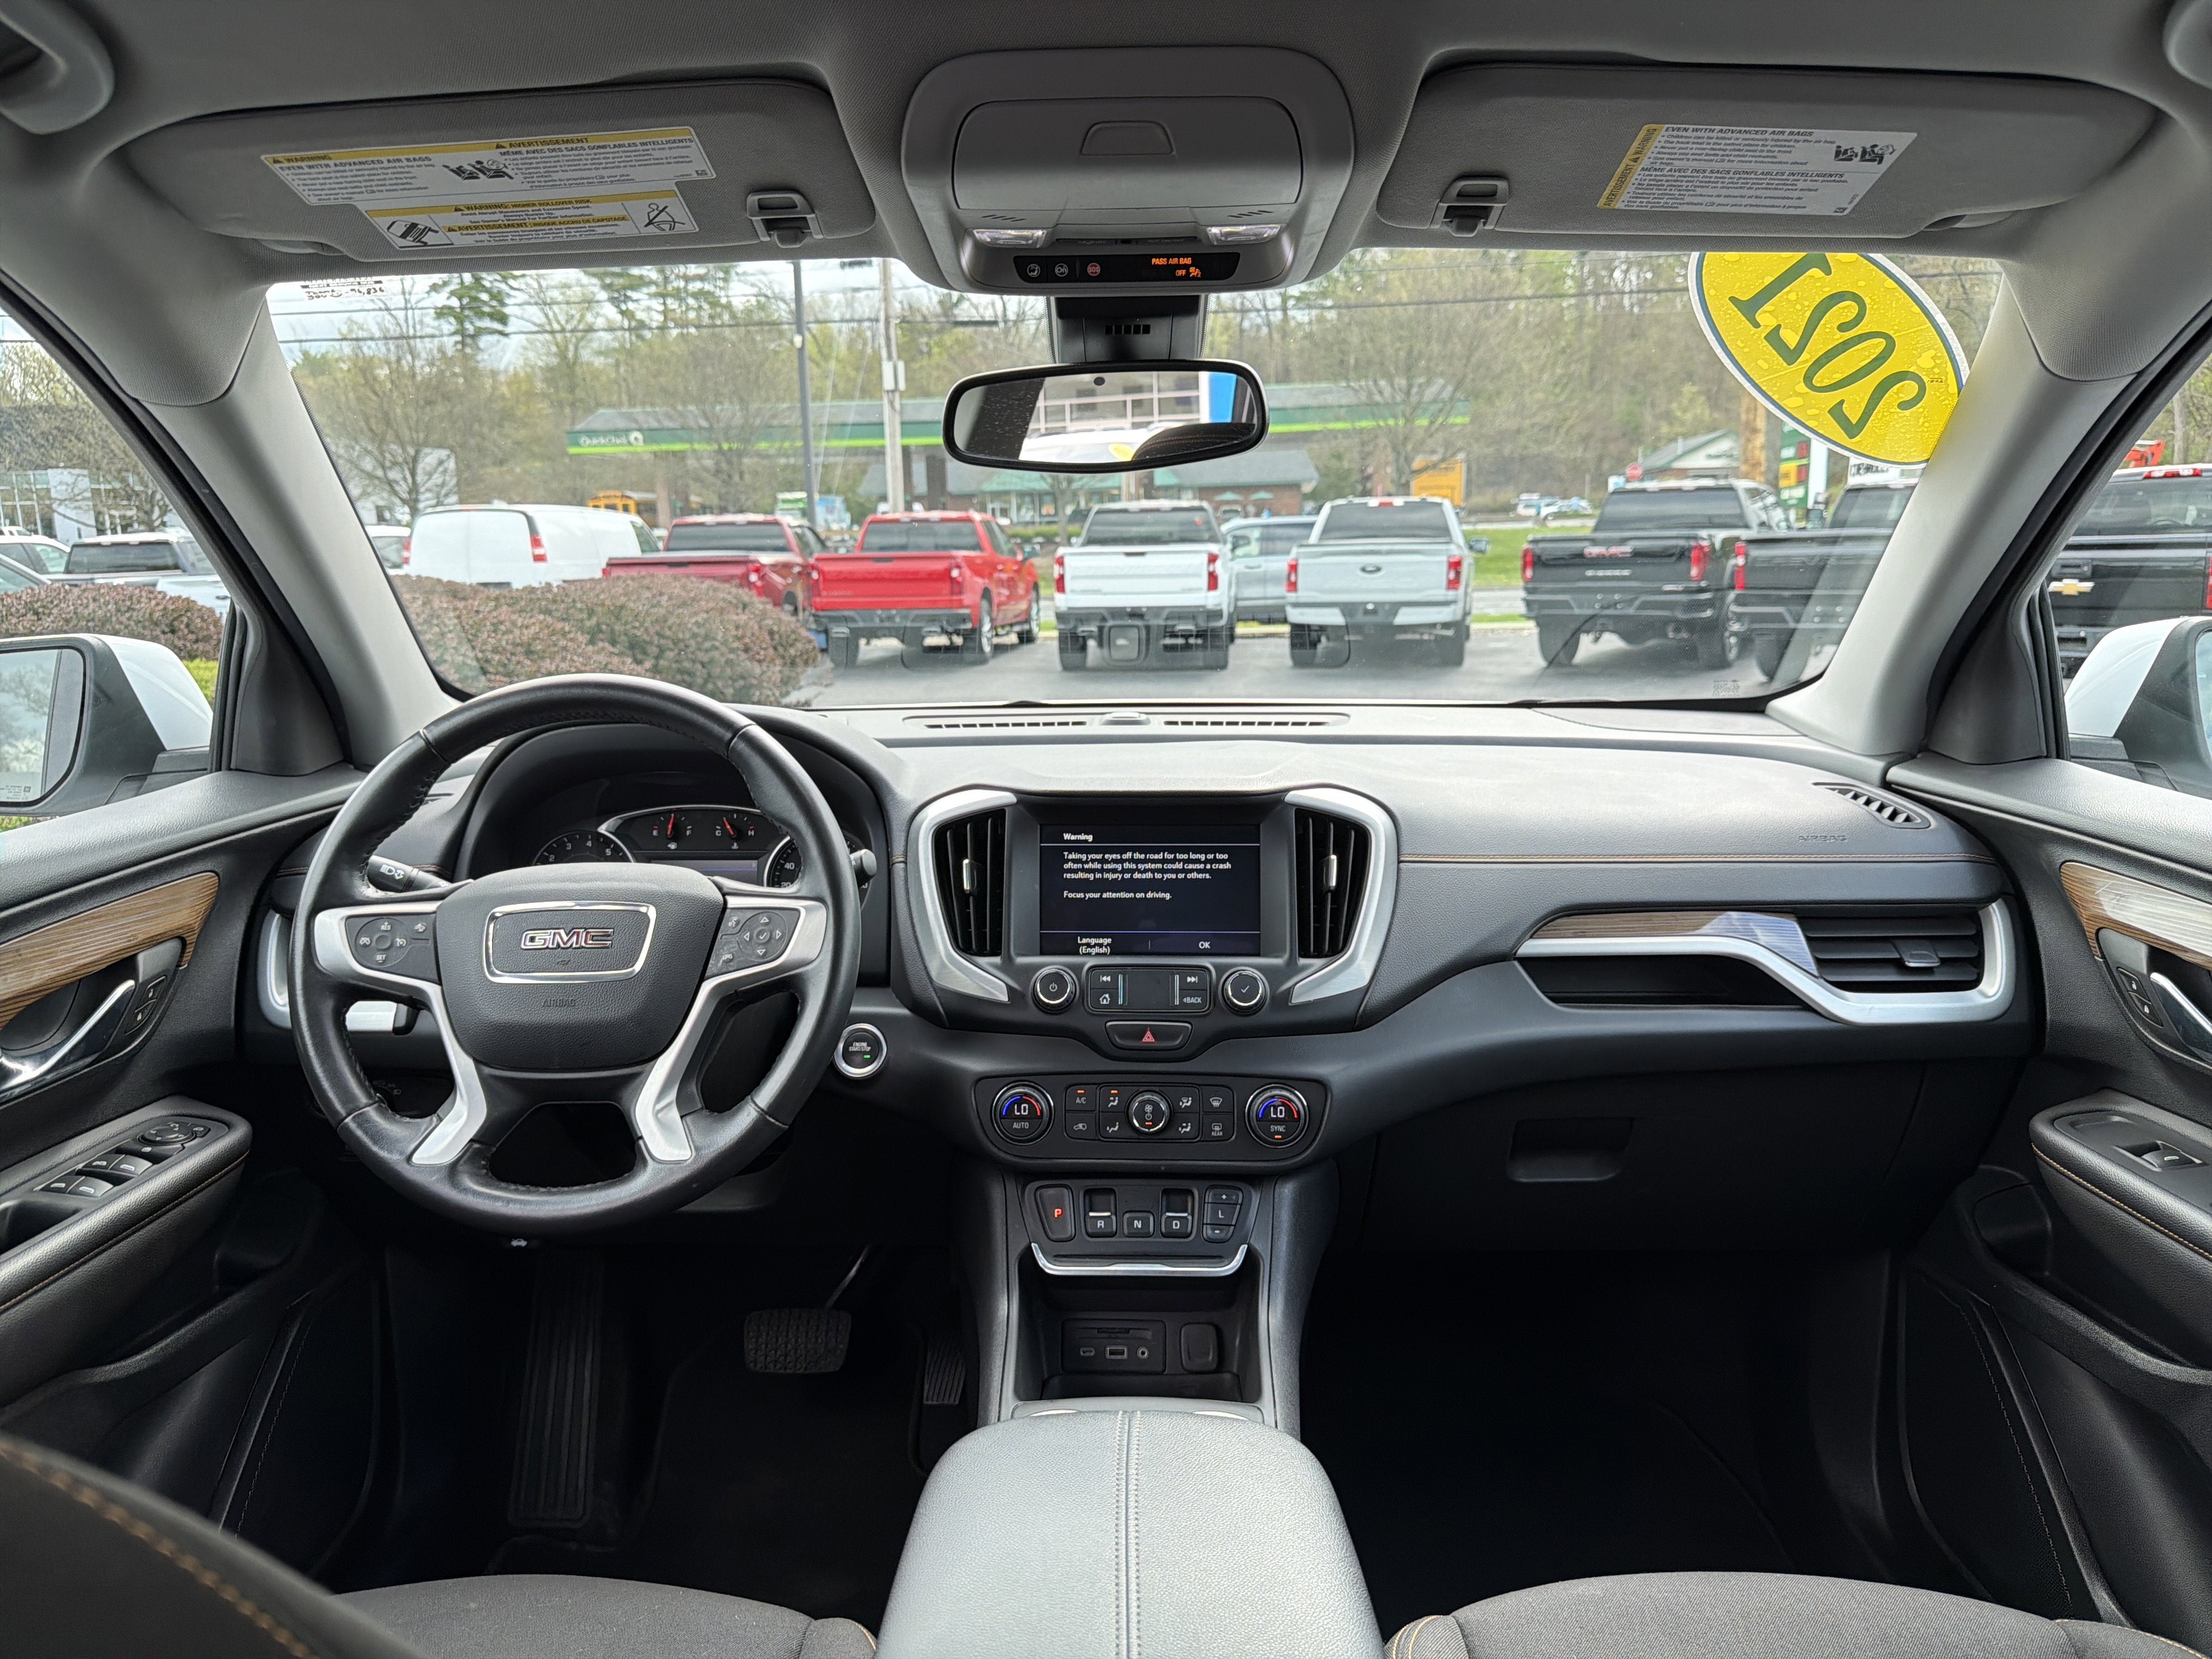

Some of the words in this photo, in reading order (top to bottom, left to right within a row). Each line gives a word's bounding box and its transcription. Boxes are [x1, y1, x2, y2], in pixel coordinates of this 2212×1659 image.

[509, 137, 589, 148] AVERTISSEMENT
[588, 142, 638, 150] GONFLABLES
[639, 138, 694, 146] INTELLIGENTS
[1633, 128, 1657, 155] WARNING
[334, 159, 383, 167] ADVANCED
[1604, 164, 1635, 206] AVERTISSEMENT
[1063, 833, 1093, 842] Warning
[1063, 852, 1086, 860] Taking
[1189, 852, 1205, 860] long
[1103, 862, 1122, 871] using
[1137, 862, 1162, 871] system
[1063, 871, 1094, 880] resulting
[1103, 872, 1122, 880] injury
[1146, 891, 1172, 900] driving.
[521, 928, 614, 950] GMC
[1077, 936, 1111, 946] Language
[1079, 946, 1110, 955] (English)
[1076, 1097, 1087, 1105] A/C
[1014, 1104, 1029, 1115] LO
[1271, 1107, 1285, 1119] LO
[1013, 1121, 1029, 1130] AUTO
[1054, 1209, 1063, 1218] P
[1218, 1210, 1224, 1218] L
[1098, 1220, 1104, 1228] R
[1134, 1220, 1142, 1228] N
[1173, 1220, 1180, 1229] D
